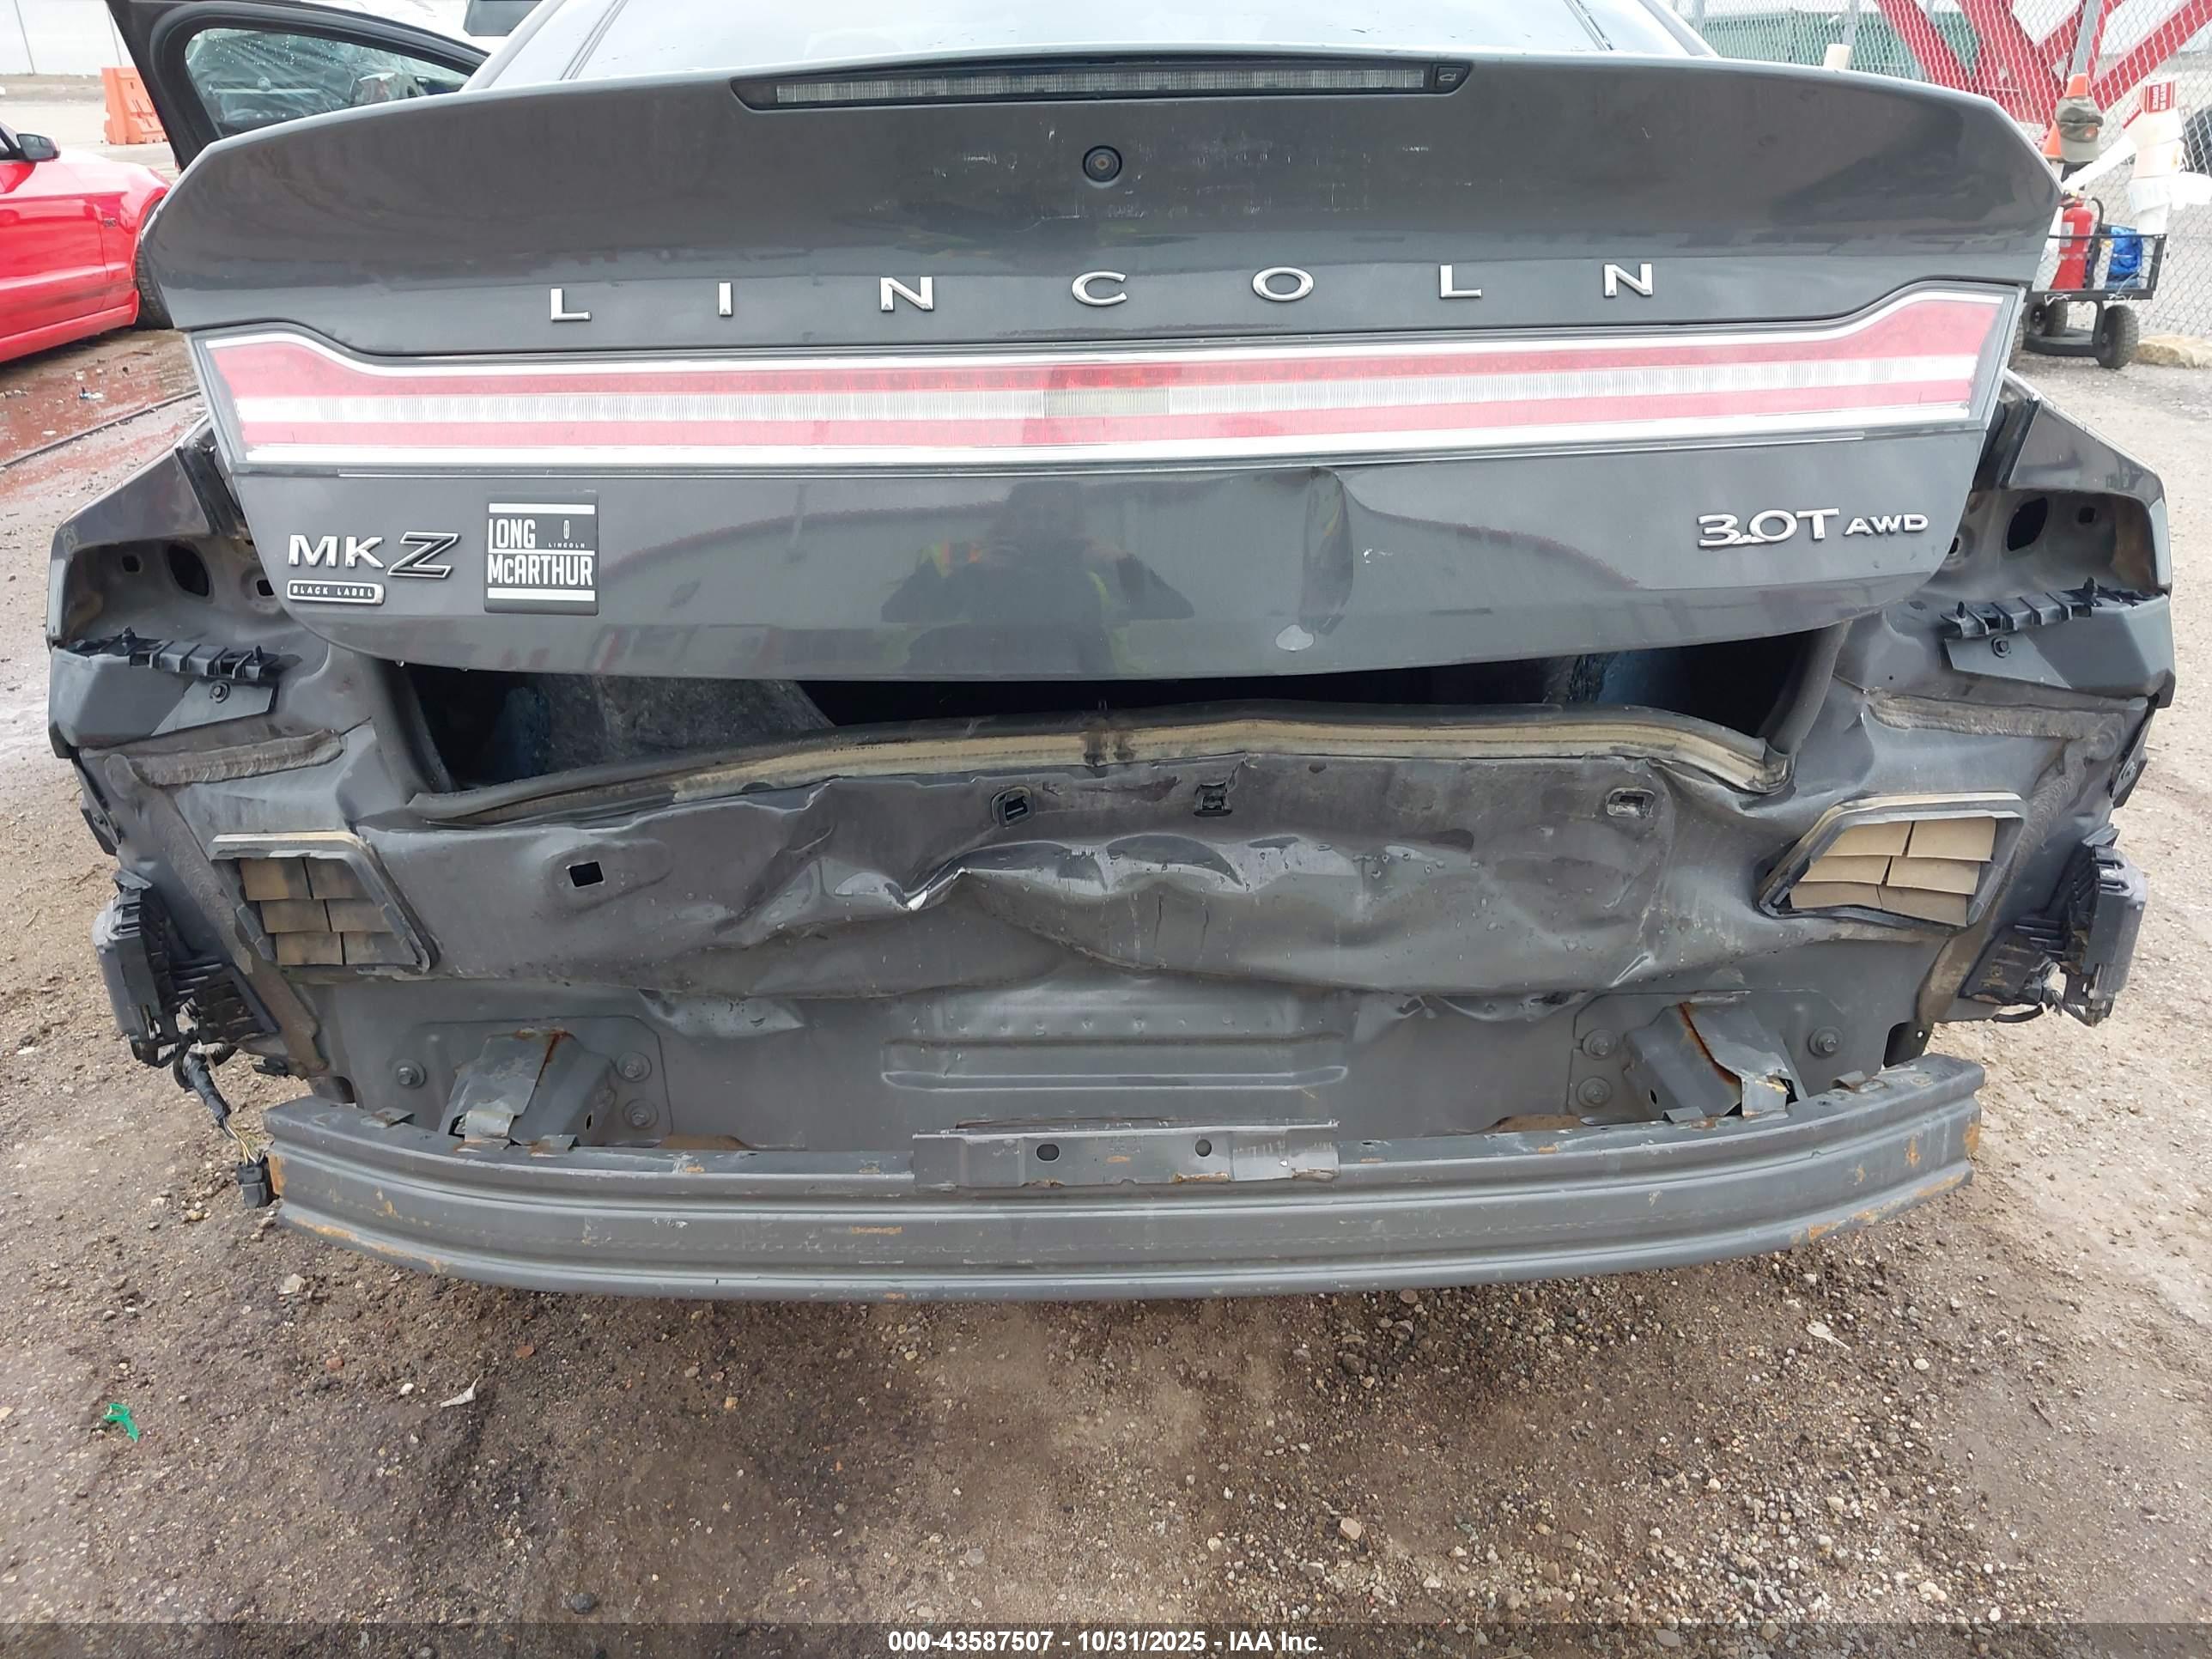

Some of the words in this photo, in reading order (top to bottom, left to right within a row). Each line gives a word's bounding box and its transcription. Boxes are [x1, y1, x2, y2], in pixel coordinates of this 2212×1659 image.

[548, 262, 1655, 321] LINCOLN
[487, 518, 536, 550] LONG
[1844, 514, 1929, 536] AWD
[288, 532, 460, 578] MKZ
[487, 555, 593, 586] McARTHUR
[292, 586, 329, 596] BLACK
[337, 586, 373, 598] LABEL
